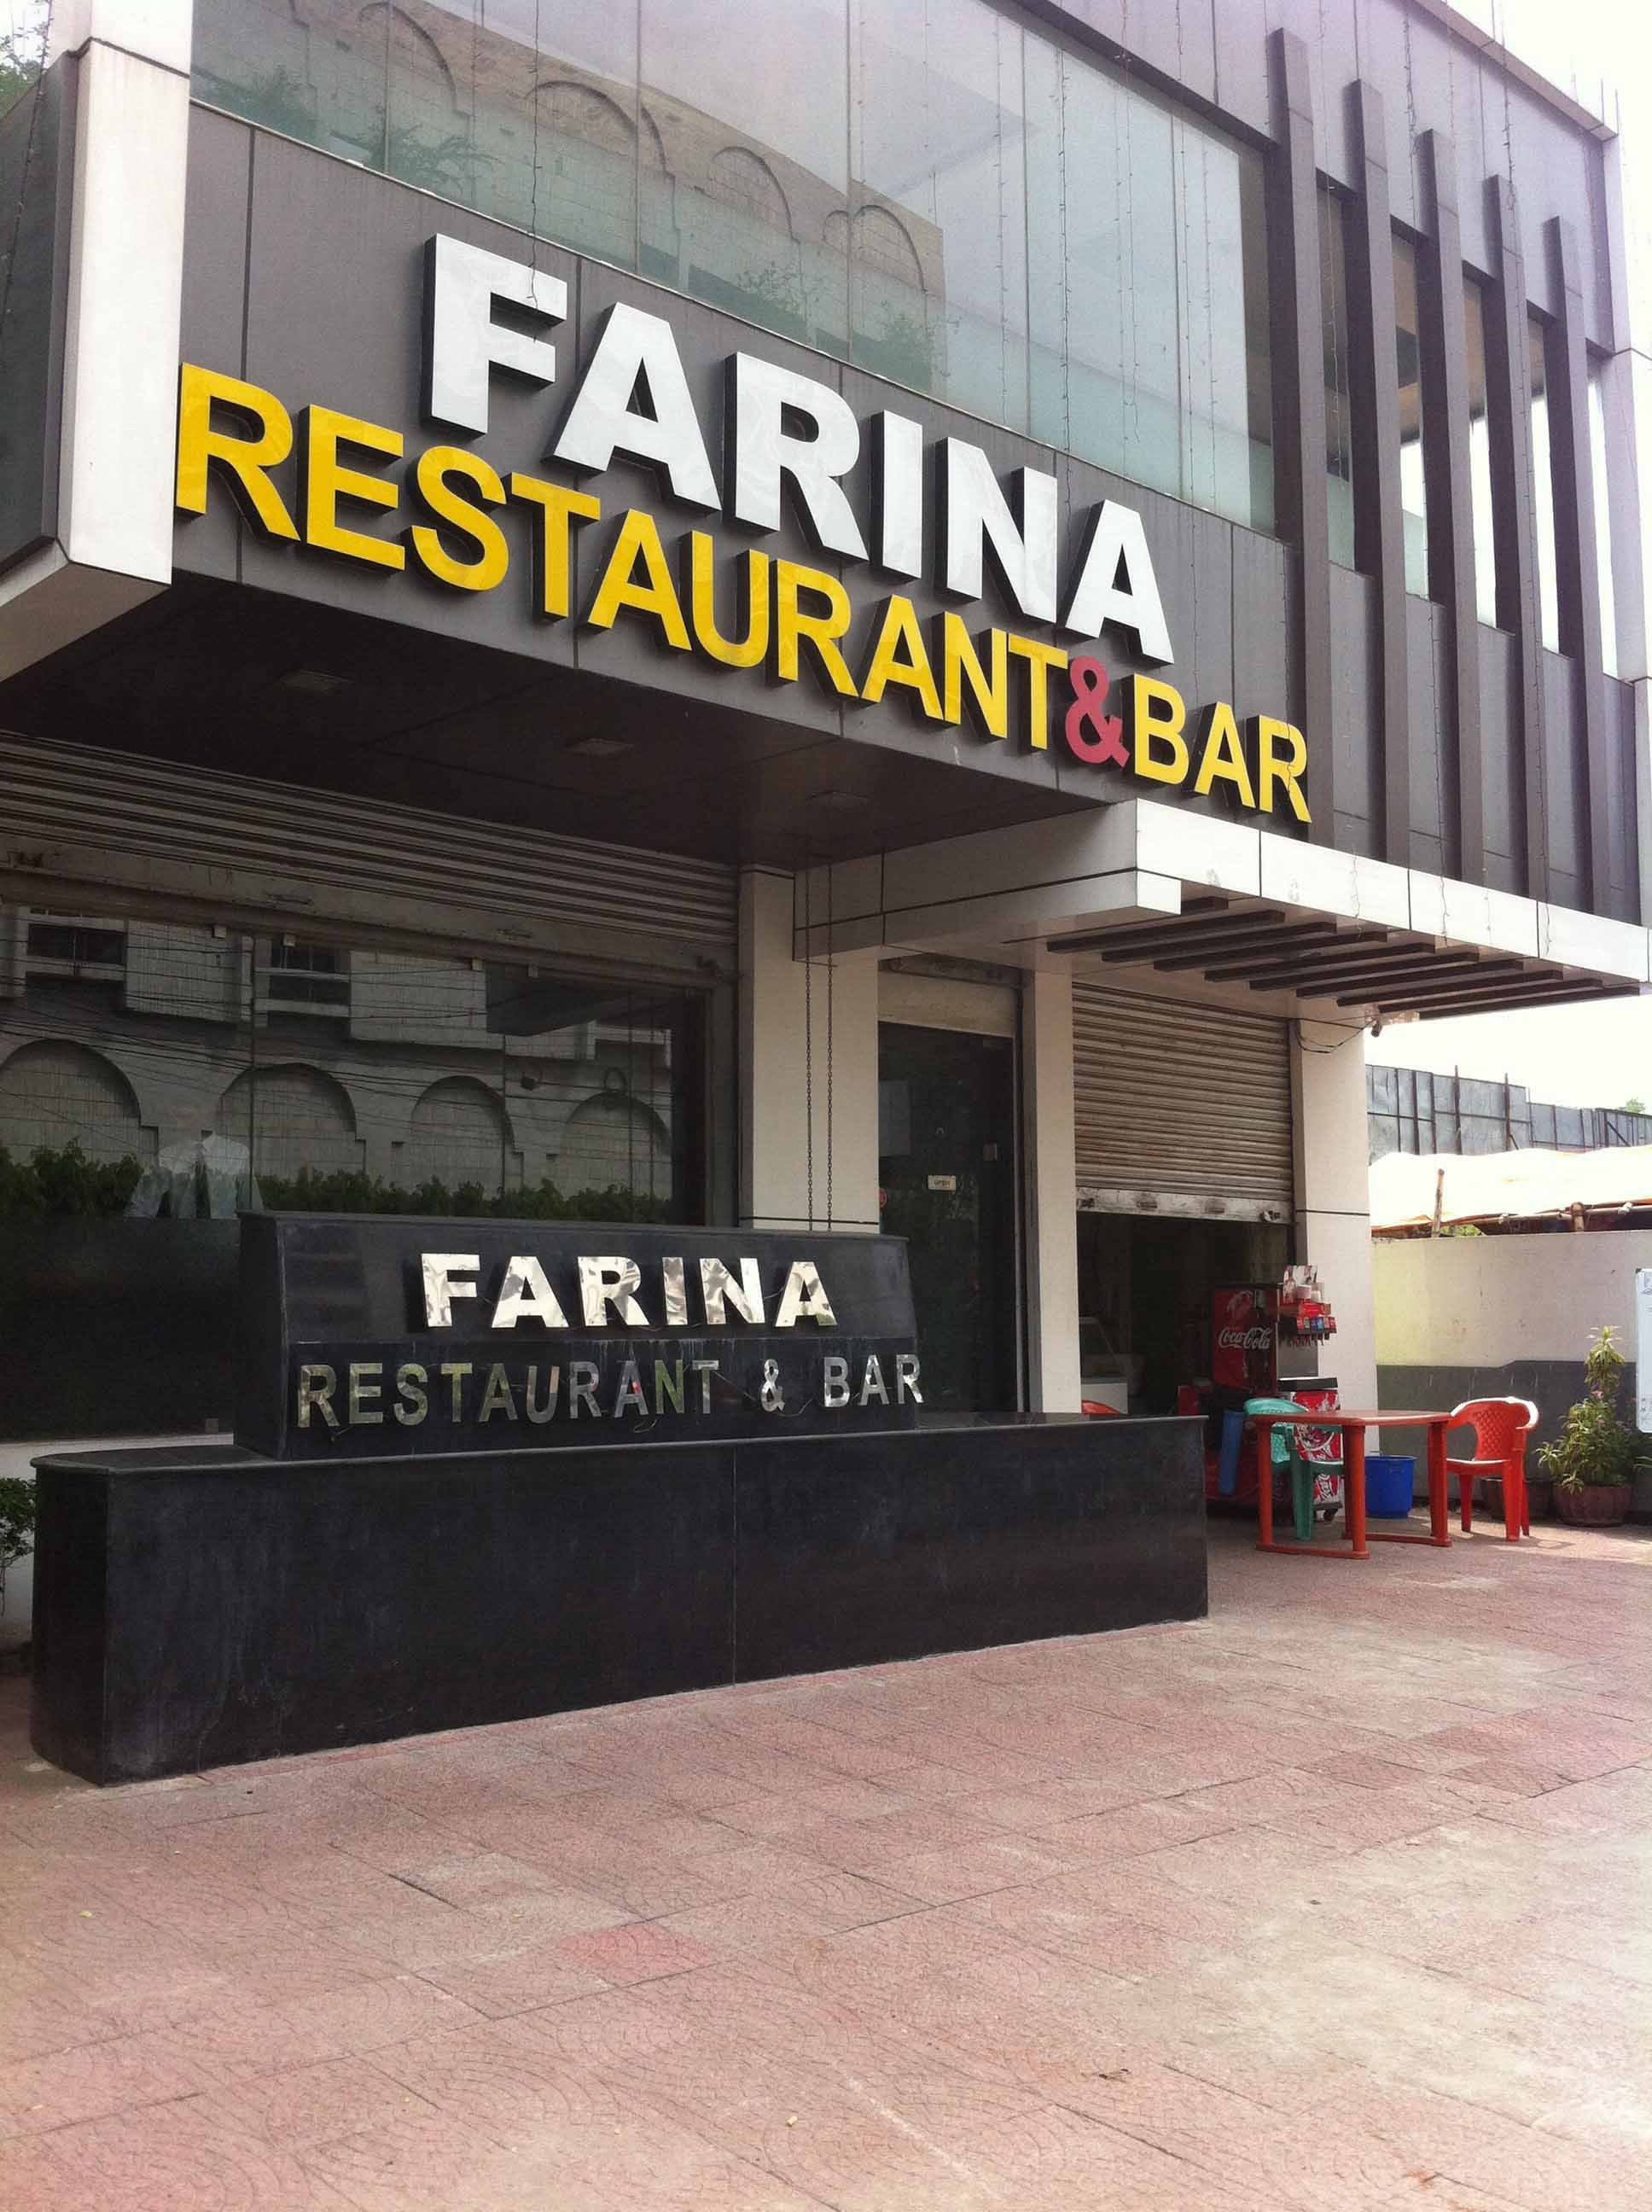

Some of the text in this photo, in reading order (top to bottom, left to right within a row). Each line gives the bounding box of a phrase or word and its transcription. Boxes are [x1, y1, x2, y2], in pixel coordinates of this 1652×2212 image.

[430, 233, 1175, 666] FARINA
[420, 1252, 836, 1329] FARINA
[1218, 1326, 1271, 1349] Coca-Cola
[297, 1353, 925, 1429] RESTAURANT & BAR
